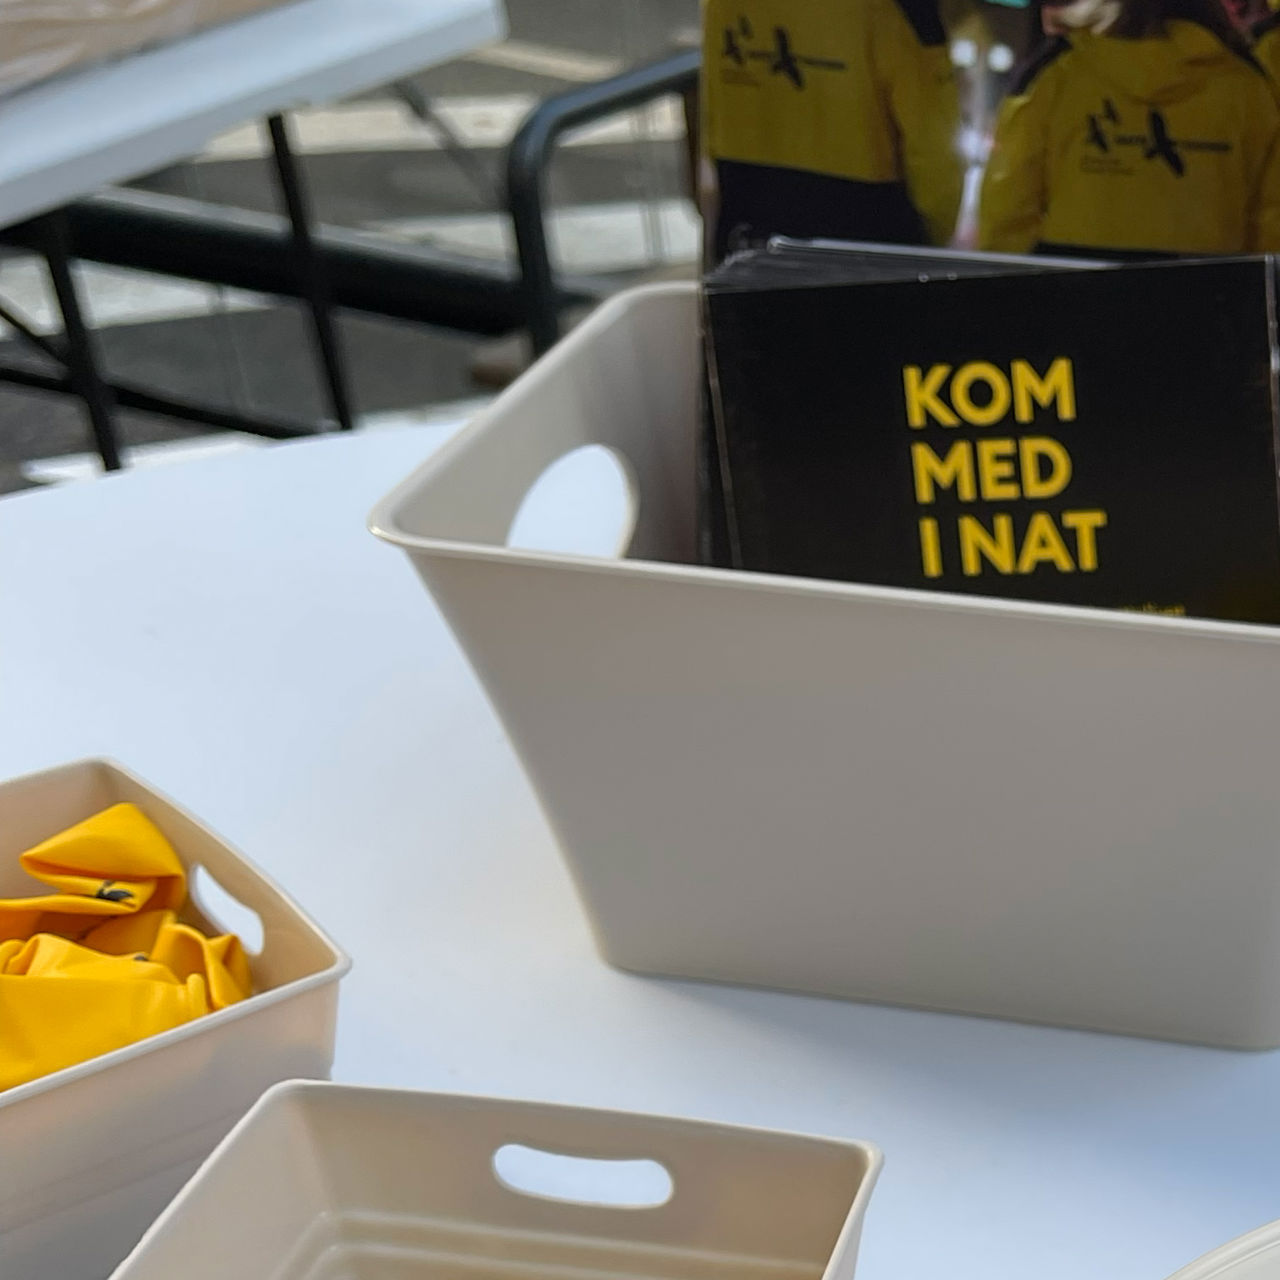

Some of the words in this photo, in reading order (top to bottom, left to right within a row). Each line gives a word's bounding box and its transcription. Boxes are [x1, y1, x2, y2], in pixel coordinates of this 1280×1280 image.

[902, 357, 1077, 429] KOM
[910, 436, 1073, 504] MED
[918, 516, 943, 578] I
[957, 509, 1108, 577] NAT
